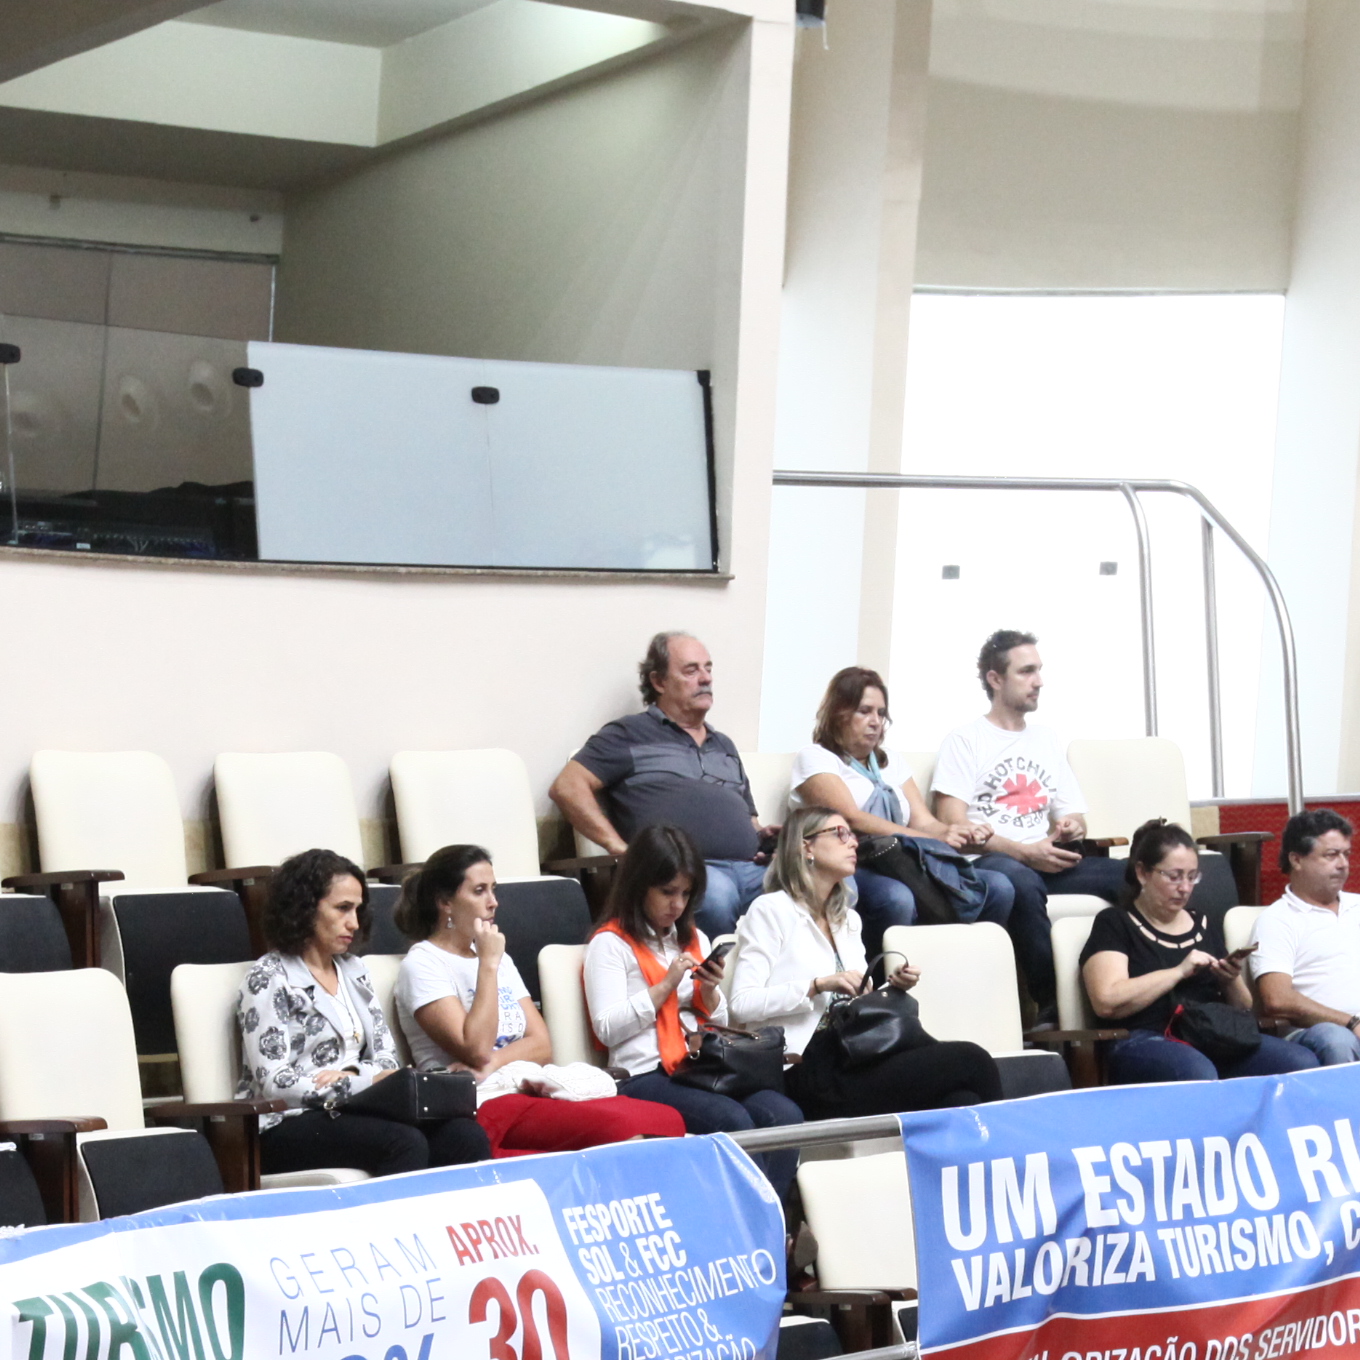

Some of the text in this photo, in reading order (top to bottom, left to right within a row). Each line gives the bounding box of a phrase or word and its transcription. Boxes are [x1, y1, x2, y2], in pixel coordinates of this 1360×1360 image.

[983, 757, 1013, 790] HOT
[561, 1192, 674, 1246] FESPORTE
[941, 1151, 1058, 1252] UM
[1071, 1132, 1280, 1228] ESTADO
[269, 1233, 438, 1300] GERAM
[445, 1214, 540, 1266] APROX.
[578, 1230, 687, 1285] SOL & FCC
[951, 1230, 1156, 1312] VALORIZA
[1156, 1210, 1335, 1280] TURISMO,
[594, 1248, 777, 1323] RECONHECIMENTO
[279, 1277, 447, 1356] MAIS DE
[697, 1308, 723, 1342] &
